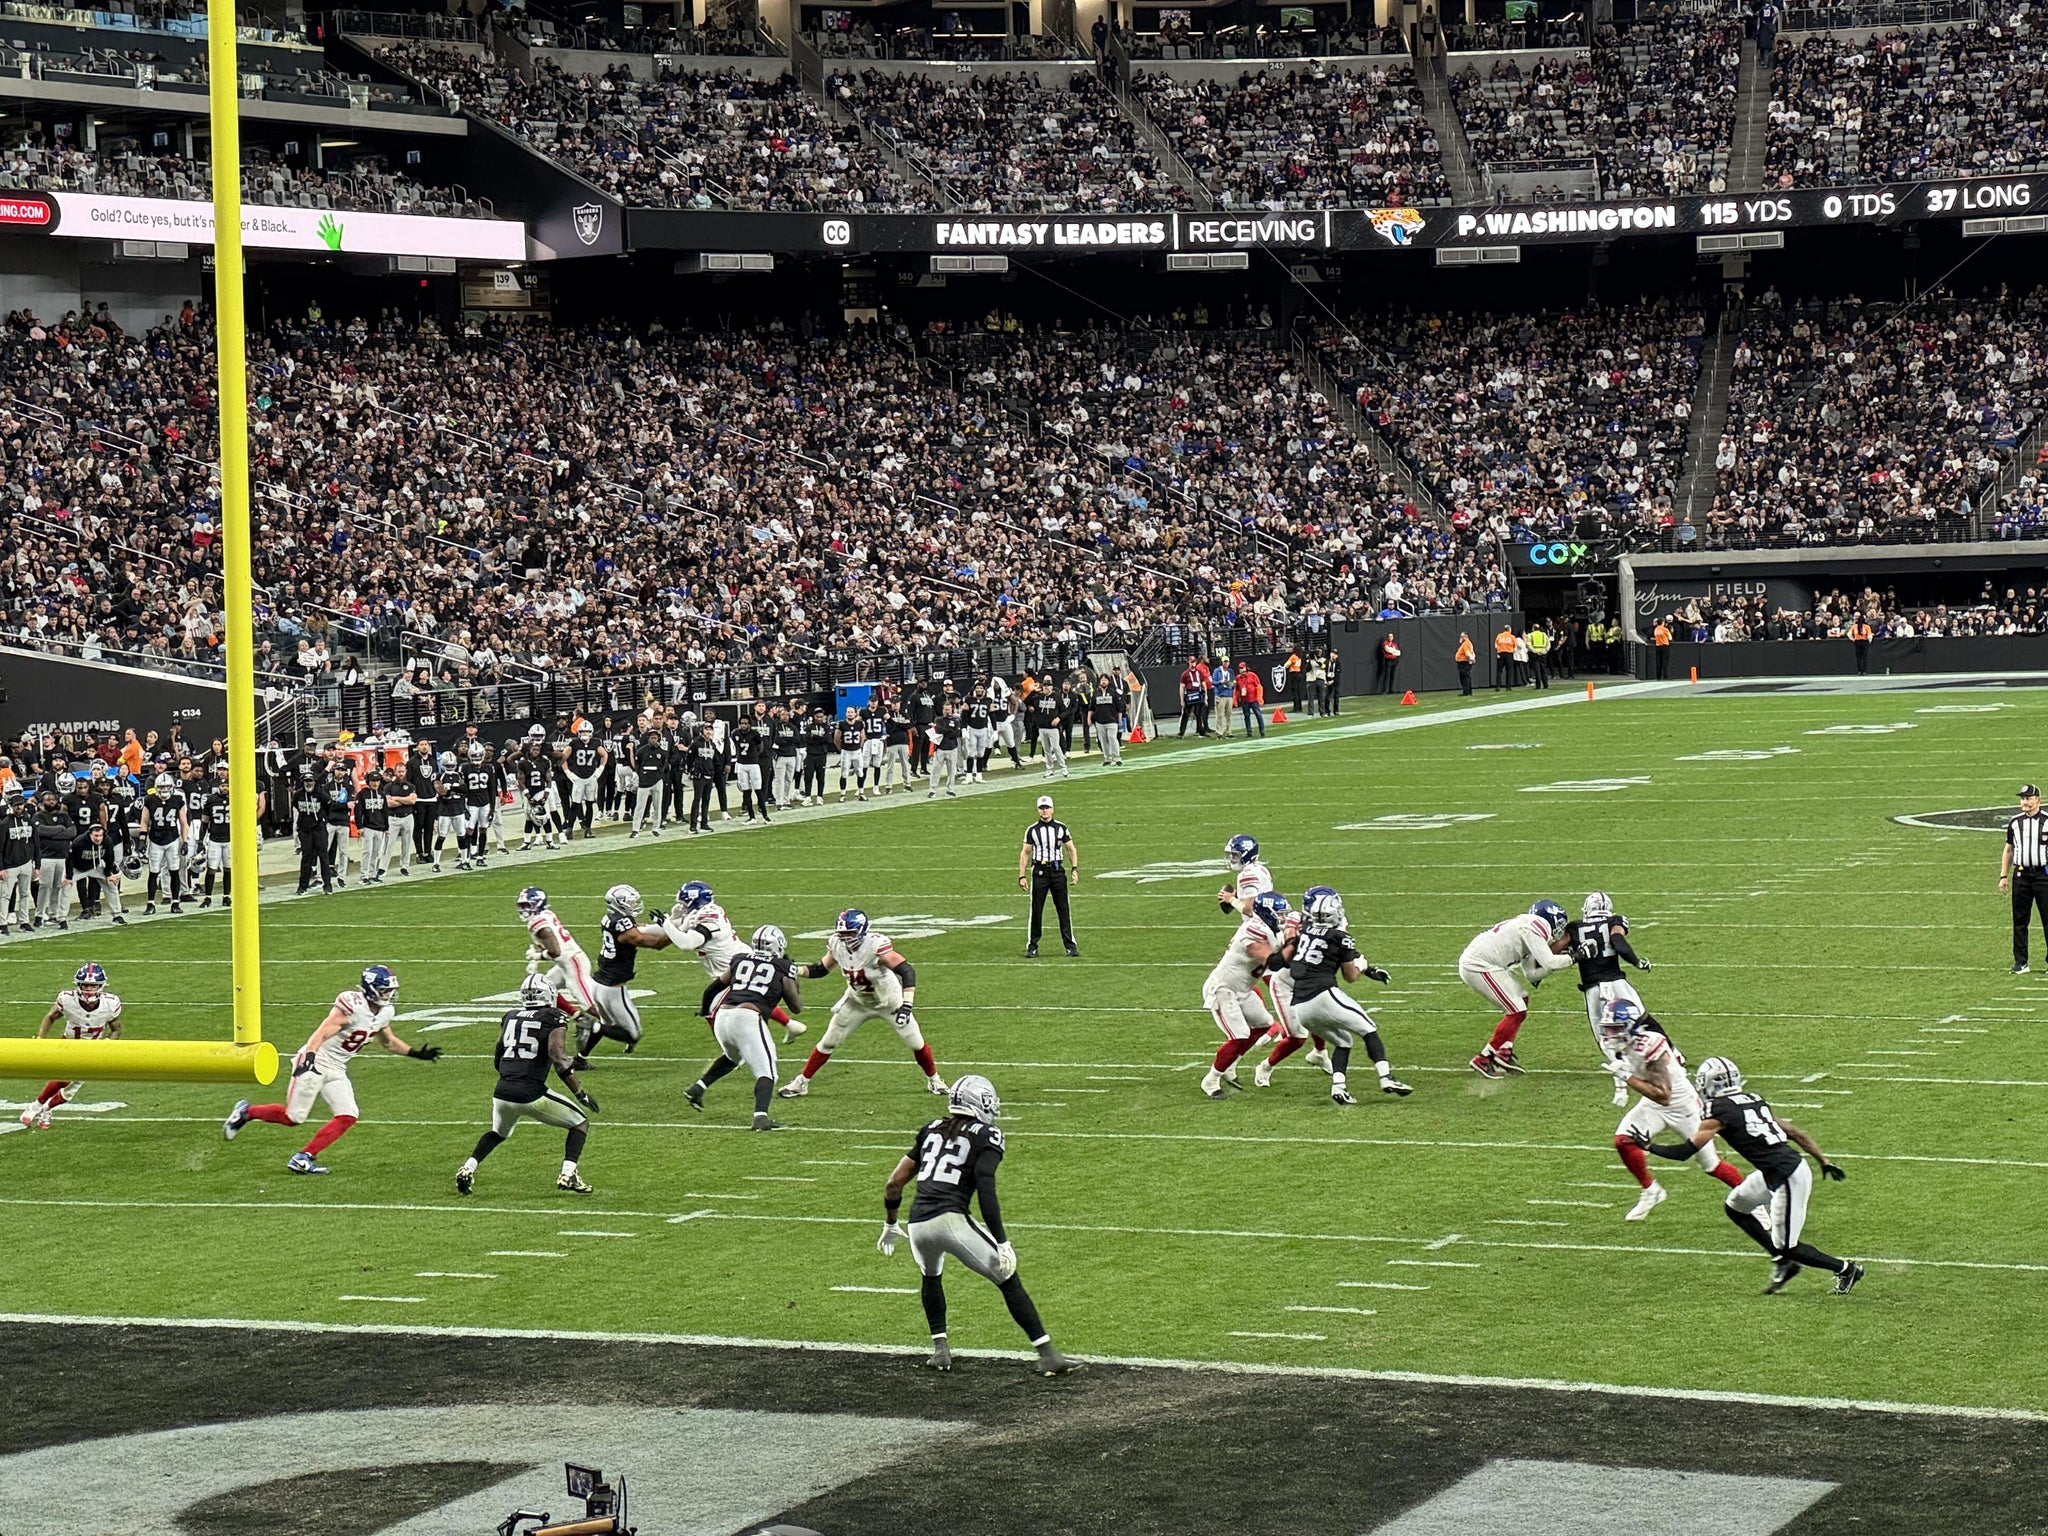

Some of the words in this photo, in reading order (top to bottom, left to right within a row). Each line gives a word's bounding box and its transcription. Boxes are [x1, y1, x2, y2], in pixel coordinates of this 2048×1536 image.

[658, 58, 673, 66] 243
[1575, 50, 1591, 58] 246
[956, 65, 972, 73] 244
[1269, 62, 1285, 70] 245
[0, 205, 44, 219] ING.COM
[1458, 206, 1676, 236] P.WASHINGTON
[1701, 200, 1739, 225] 115
[1745, 199, 1793, 223] YDS
[1824, 195, 1843, 219] 0
[1848, 192, 1896, 216] TDS
[1927, 187, 1957, 212] 37
[1962, 183, 2031, 210] LONG
[91, 208, 122, 223] Gold?
[124, 210, 149, 224] Cute
[151, 215, 172, 228] yes,
[173, 213, 190, 227] but
[252, 218, 259, 231] &
[261, 219, 297, 234] Black...
[826, 225, 847, 241] CC
[936, 223, 1049, 246] FANTASY
[1054, 222, 1166, 245] LEADERS
[1190, 219, 1316, 243] RECEIVING
[496, 274, 509, 284] 139
[524, 275, 537, 285] 140
[1808, 532, 1826, 542] 143
[1530, 543, 1588, 566] COX
[1715, 582, 1767, 596] FIELD
[181, 708, 201, 717] C134
[970, 703, 987, 718] 76
[27, 719, 121, 735] CHAMPIONS
[866, 718, 882, 734] 15
[843, 731, 861, 745] 23
[576, 749, 596, 767] 87
[467, 772, 489, 790] 29
[530, 771, 542, 787] 2
[78, 806, 91, 826] 9
[154, 806, 176, 827] 44
[615, 916, 633, 932] 49
[1577, 922, 1617, 959] 51
[1292, 933, 1329, 966] 96
[732, 959, 776, 997] 92
[502, 1018, 542, 1060] 45
[1743, 1104, 1788, 1146] 41
[916, 1132, 972, 1186] 32
